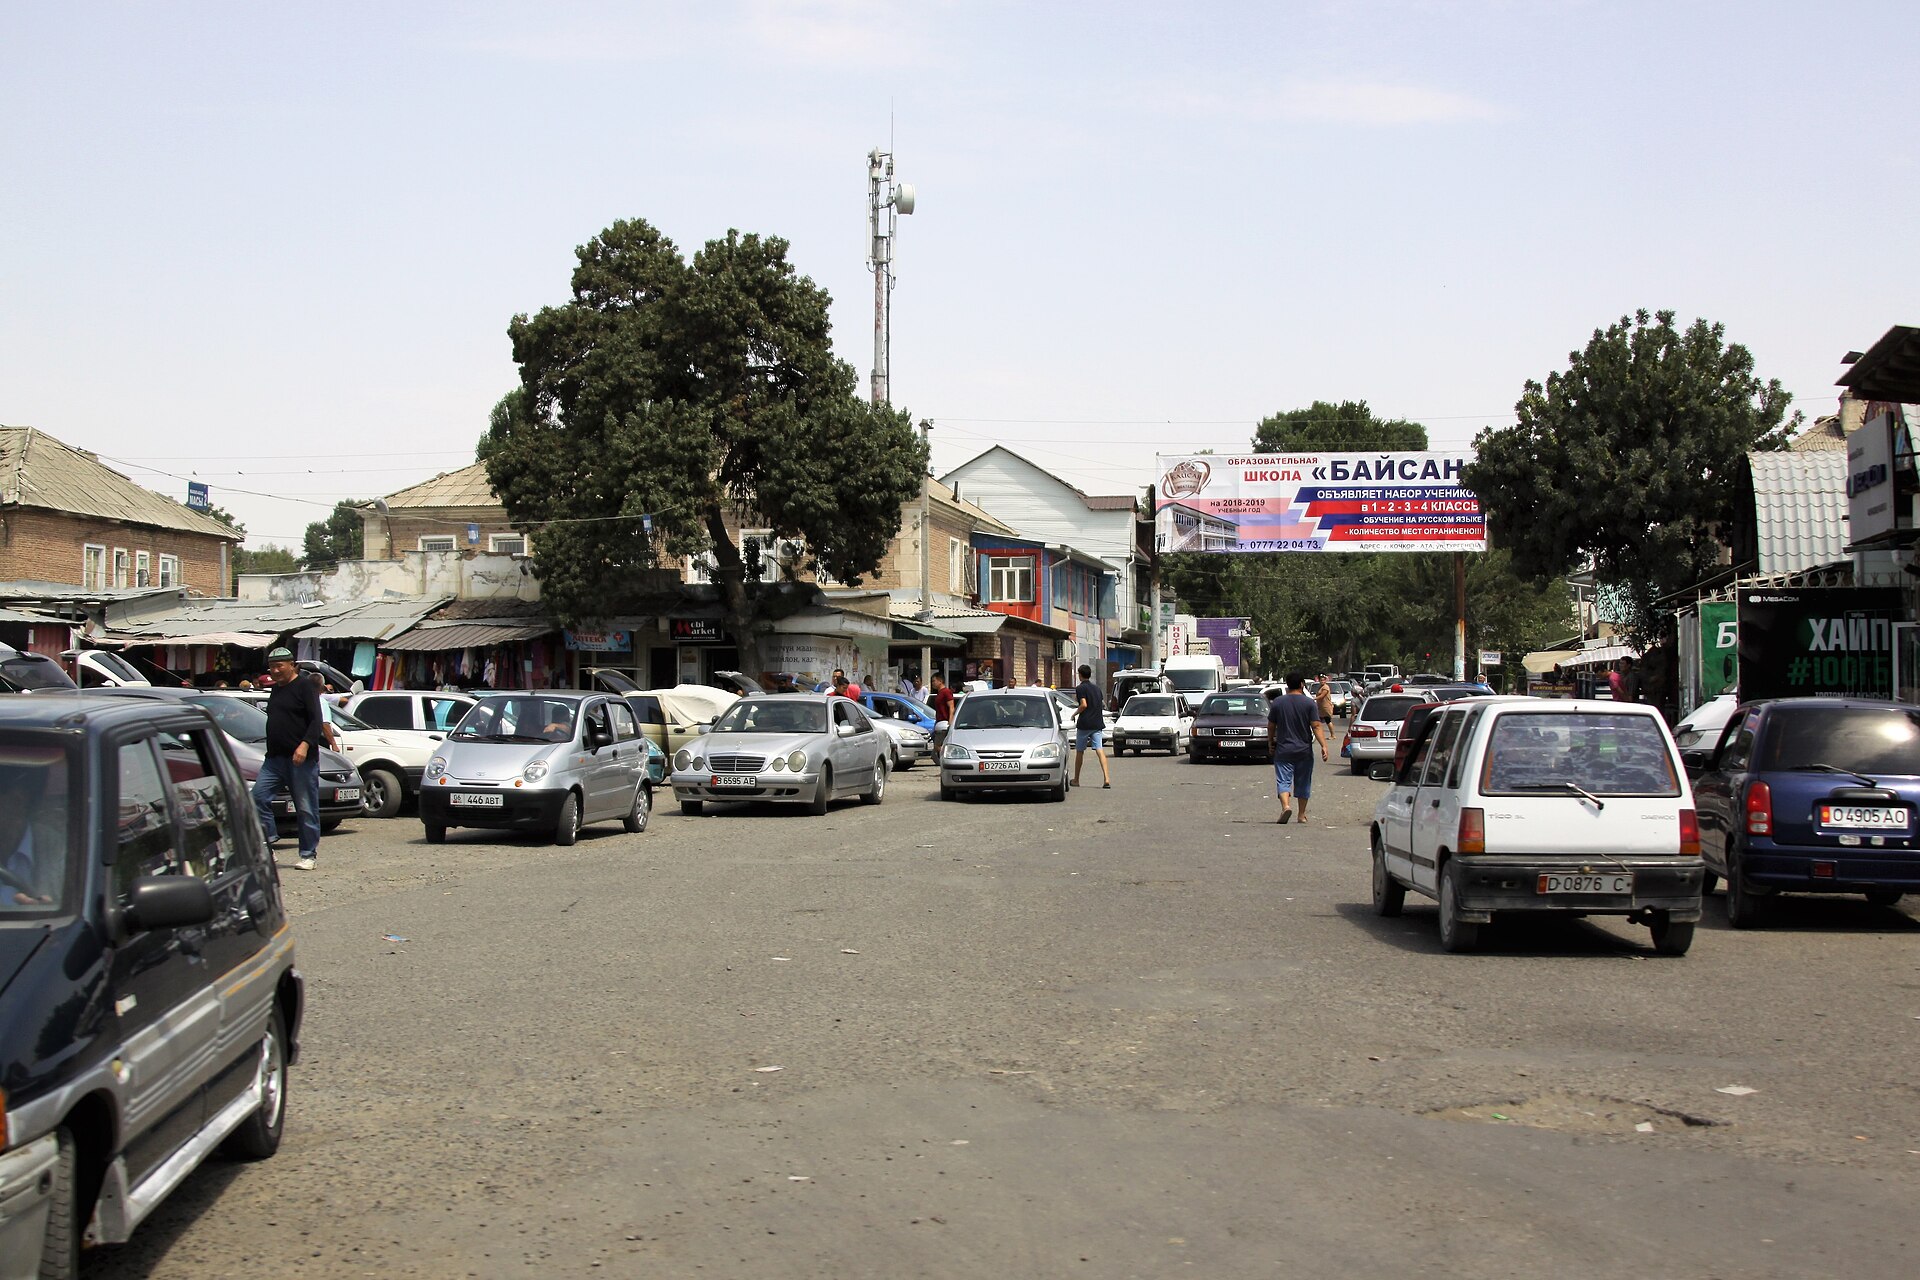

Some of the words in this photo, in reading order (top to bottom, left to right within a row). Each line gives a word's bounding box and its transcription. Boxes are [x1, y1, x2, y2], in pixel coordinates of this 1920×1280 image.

[1228, 457, 1318, 466] ОБРАЗОВАТЕЛЬНАЯ
[1244, 470, 1302, 481] ШКОЛА
[1317, 489, 1382, 499] ОБЪЯВЛЯЕТ
[1385, 489, 1422, 499] НАБОР
[1424, 489, 1477, 498] УЧЕНИКО
[1223, 499, 1265, 507] 2018-2019
[1361, 504, 1369, 512] в
[1250, 541, 1273, 550] 0777
[1276, 541, 1289, 549] 22
[1291, 541, 1304, 549] 04
[1306, 540, 1321, 549] 73.
[467, 795, 484, 805] 446
[485, 797, 500, 805] ABT
[1846, 809, 1880, 823] 4905
[1548, 877, 1558, 890] D
[1563, 877, 1602, 891] 0876
[1613, 878, 1624, 891] C
